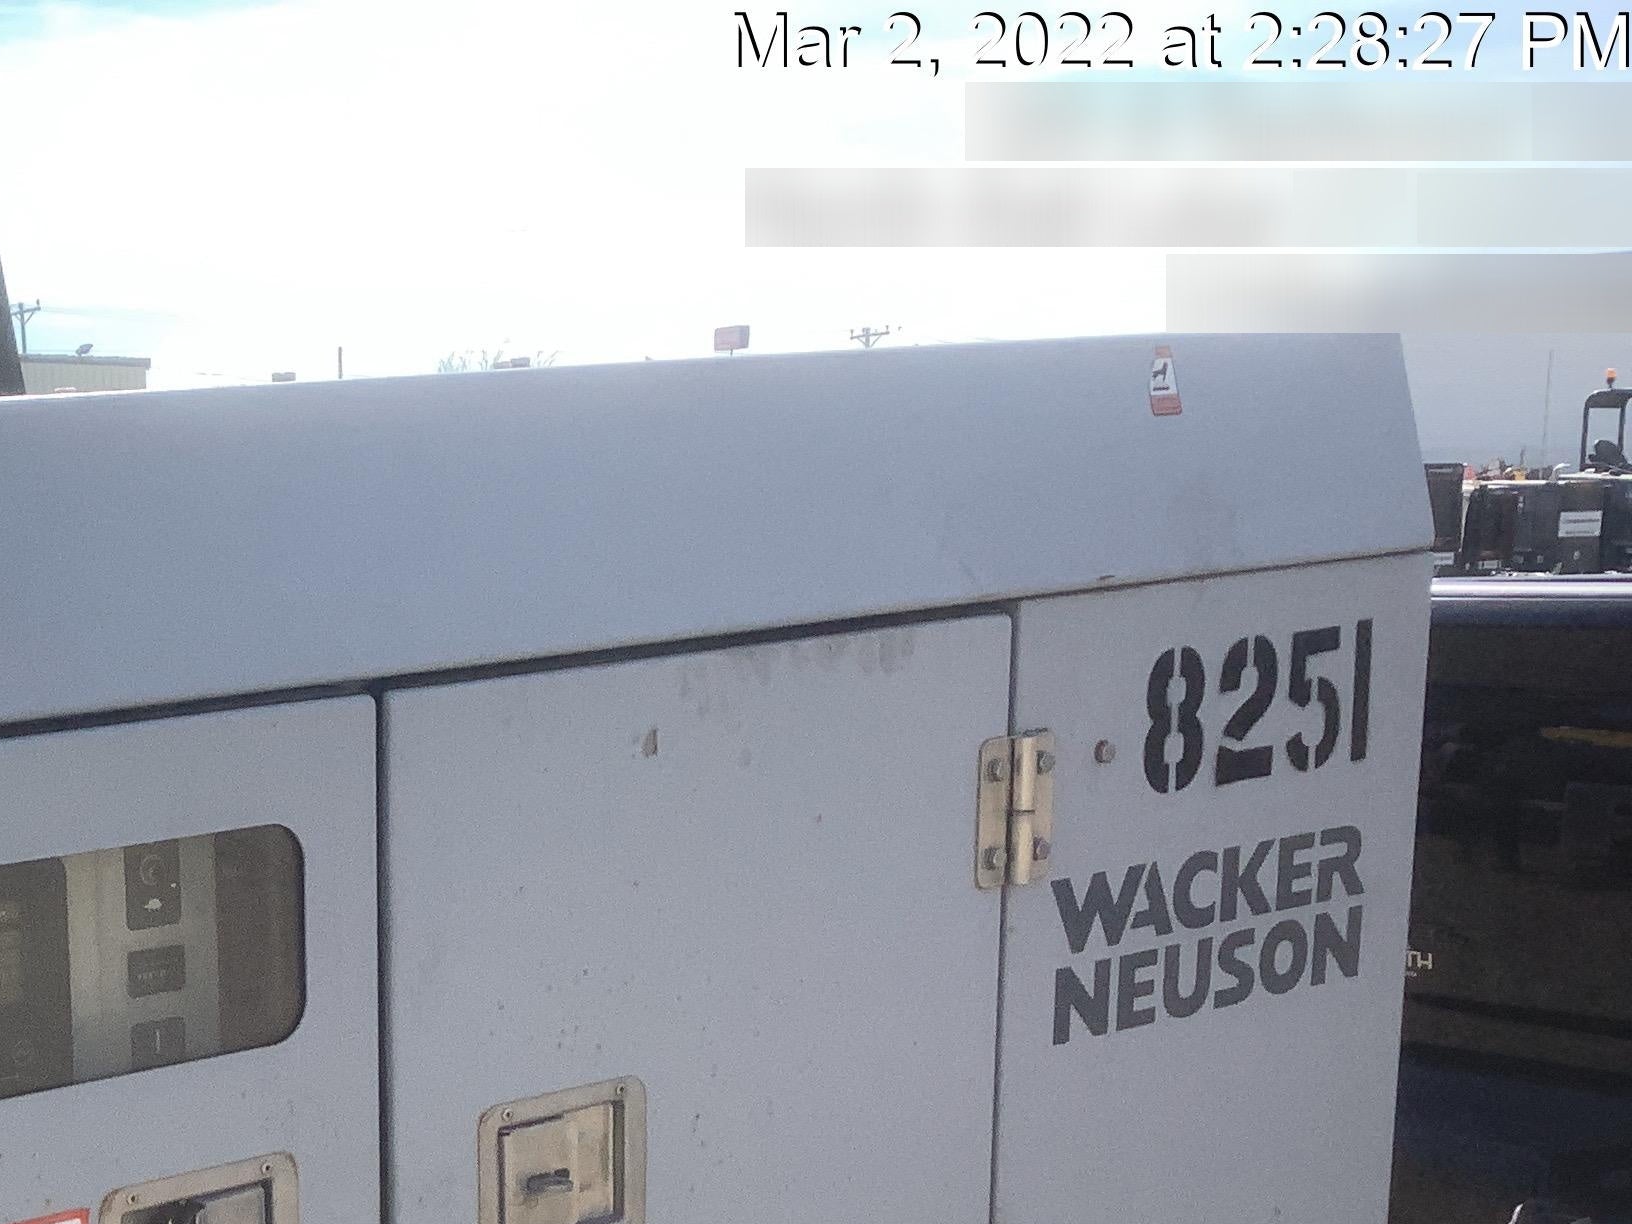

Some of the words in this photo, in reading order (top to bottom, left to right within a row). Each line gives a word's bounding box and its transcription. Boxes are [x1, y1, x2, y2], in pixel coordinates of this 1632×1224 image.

[1143, 618, 1373, 793] 8251
[1050, 825, 1366, 954] WACKER
[1052, 905, 1363, 1045] NEUSON
